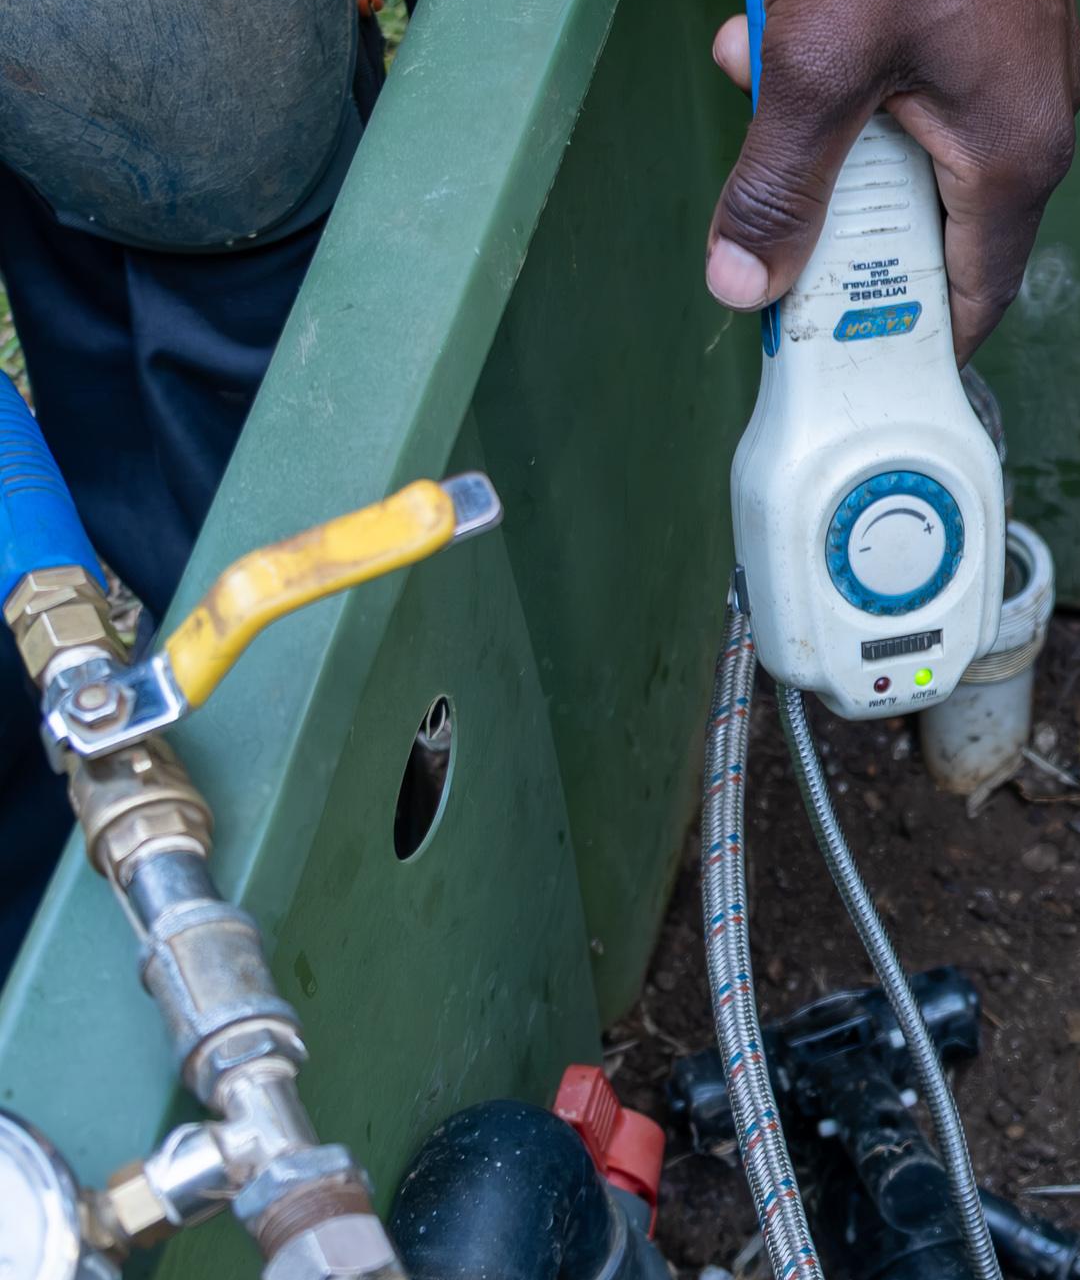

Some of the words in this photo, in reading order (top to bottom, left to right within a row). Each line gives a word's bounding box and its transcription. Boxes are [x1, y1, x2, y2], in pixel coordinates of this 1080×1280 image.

[853, 259, 899, 270] DETECTOR
[870, 269, 889, 278] GAS
[911, 688, 937, 700] READY
[868, 697, 897, 708] ALARM
